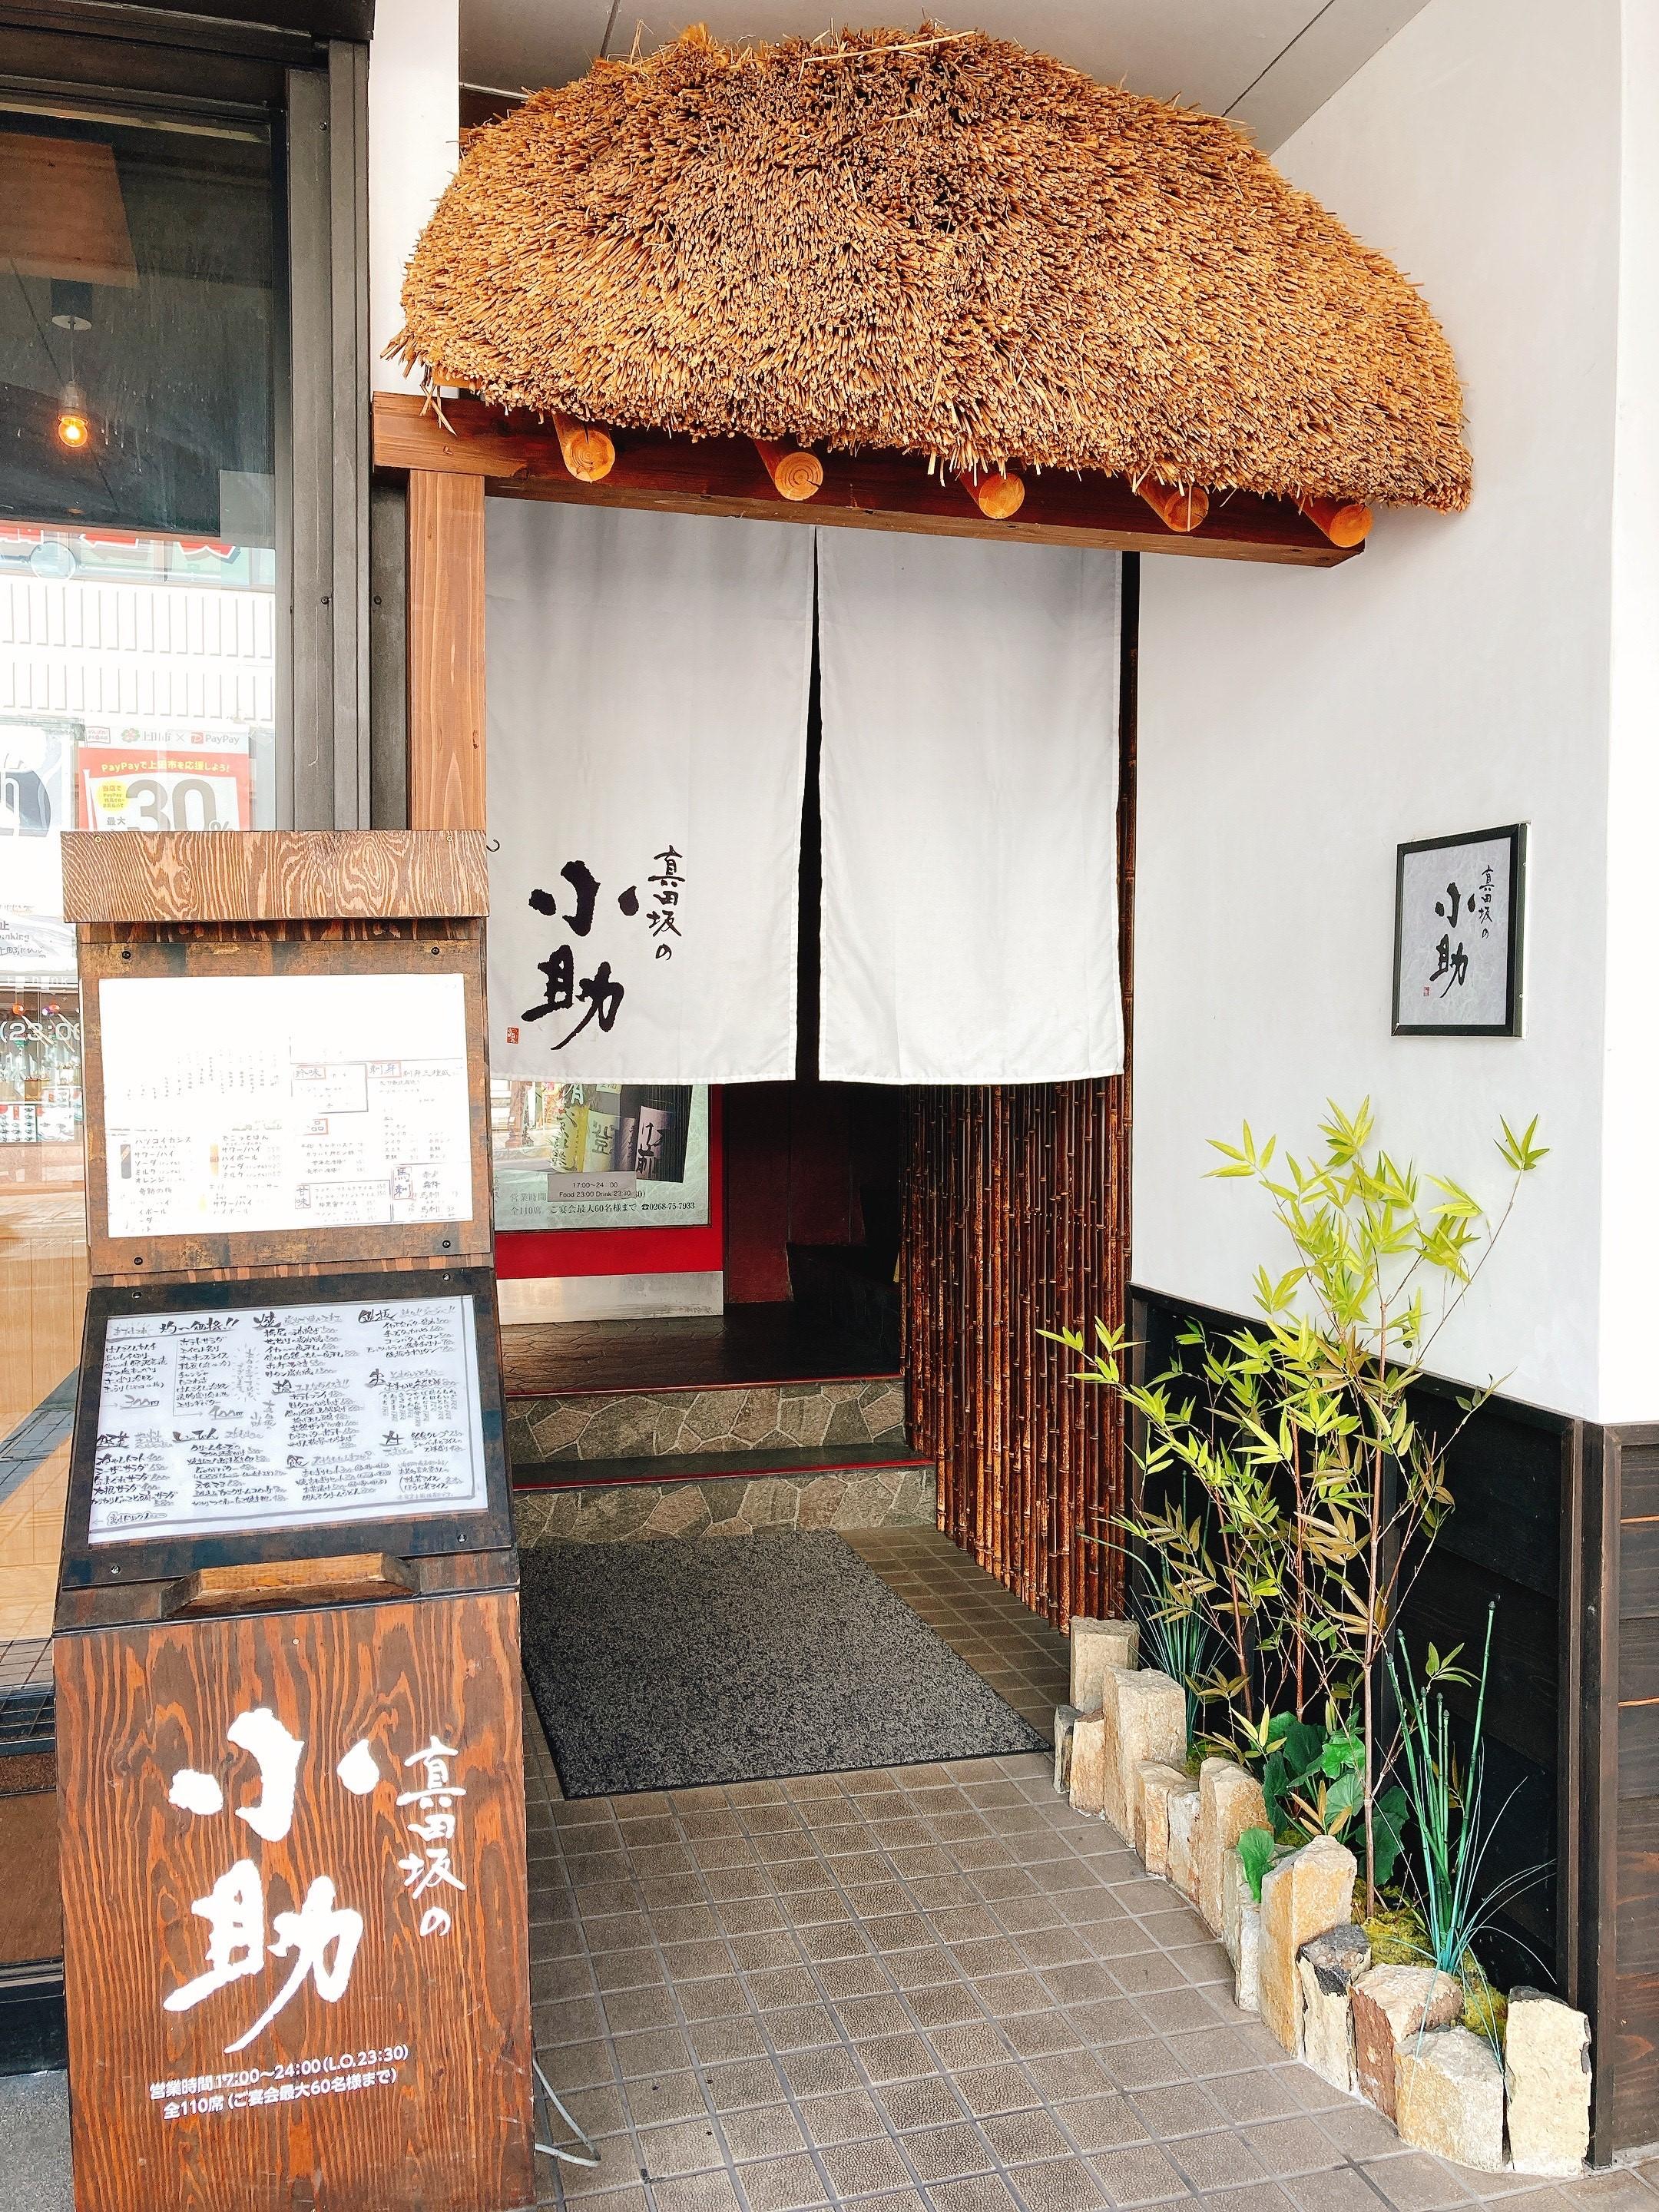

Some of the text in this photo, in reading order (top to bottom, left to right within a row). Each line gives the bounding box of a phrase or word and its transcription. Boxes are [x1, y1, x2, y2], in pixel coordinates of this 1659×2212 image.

[206, 734, 239, 745] PayPay
[107, 816, 126, 826] 最大
[521, 859, 640, 1050] 小助
[1429, 882, 1476, 998] 小助
[163, 1707, 381, 2054] 小助
[395, 1735, 467, 1938] 真田坂の
